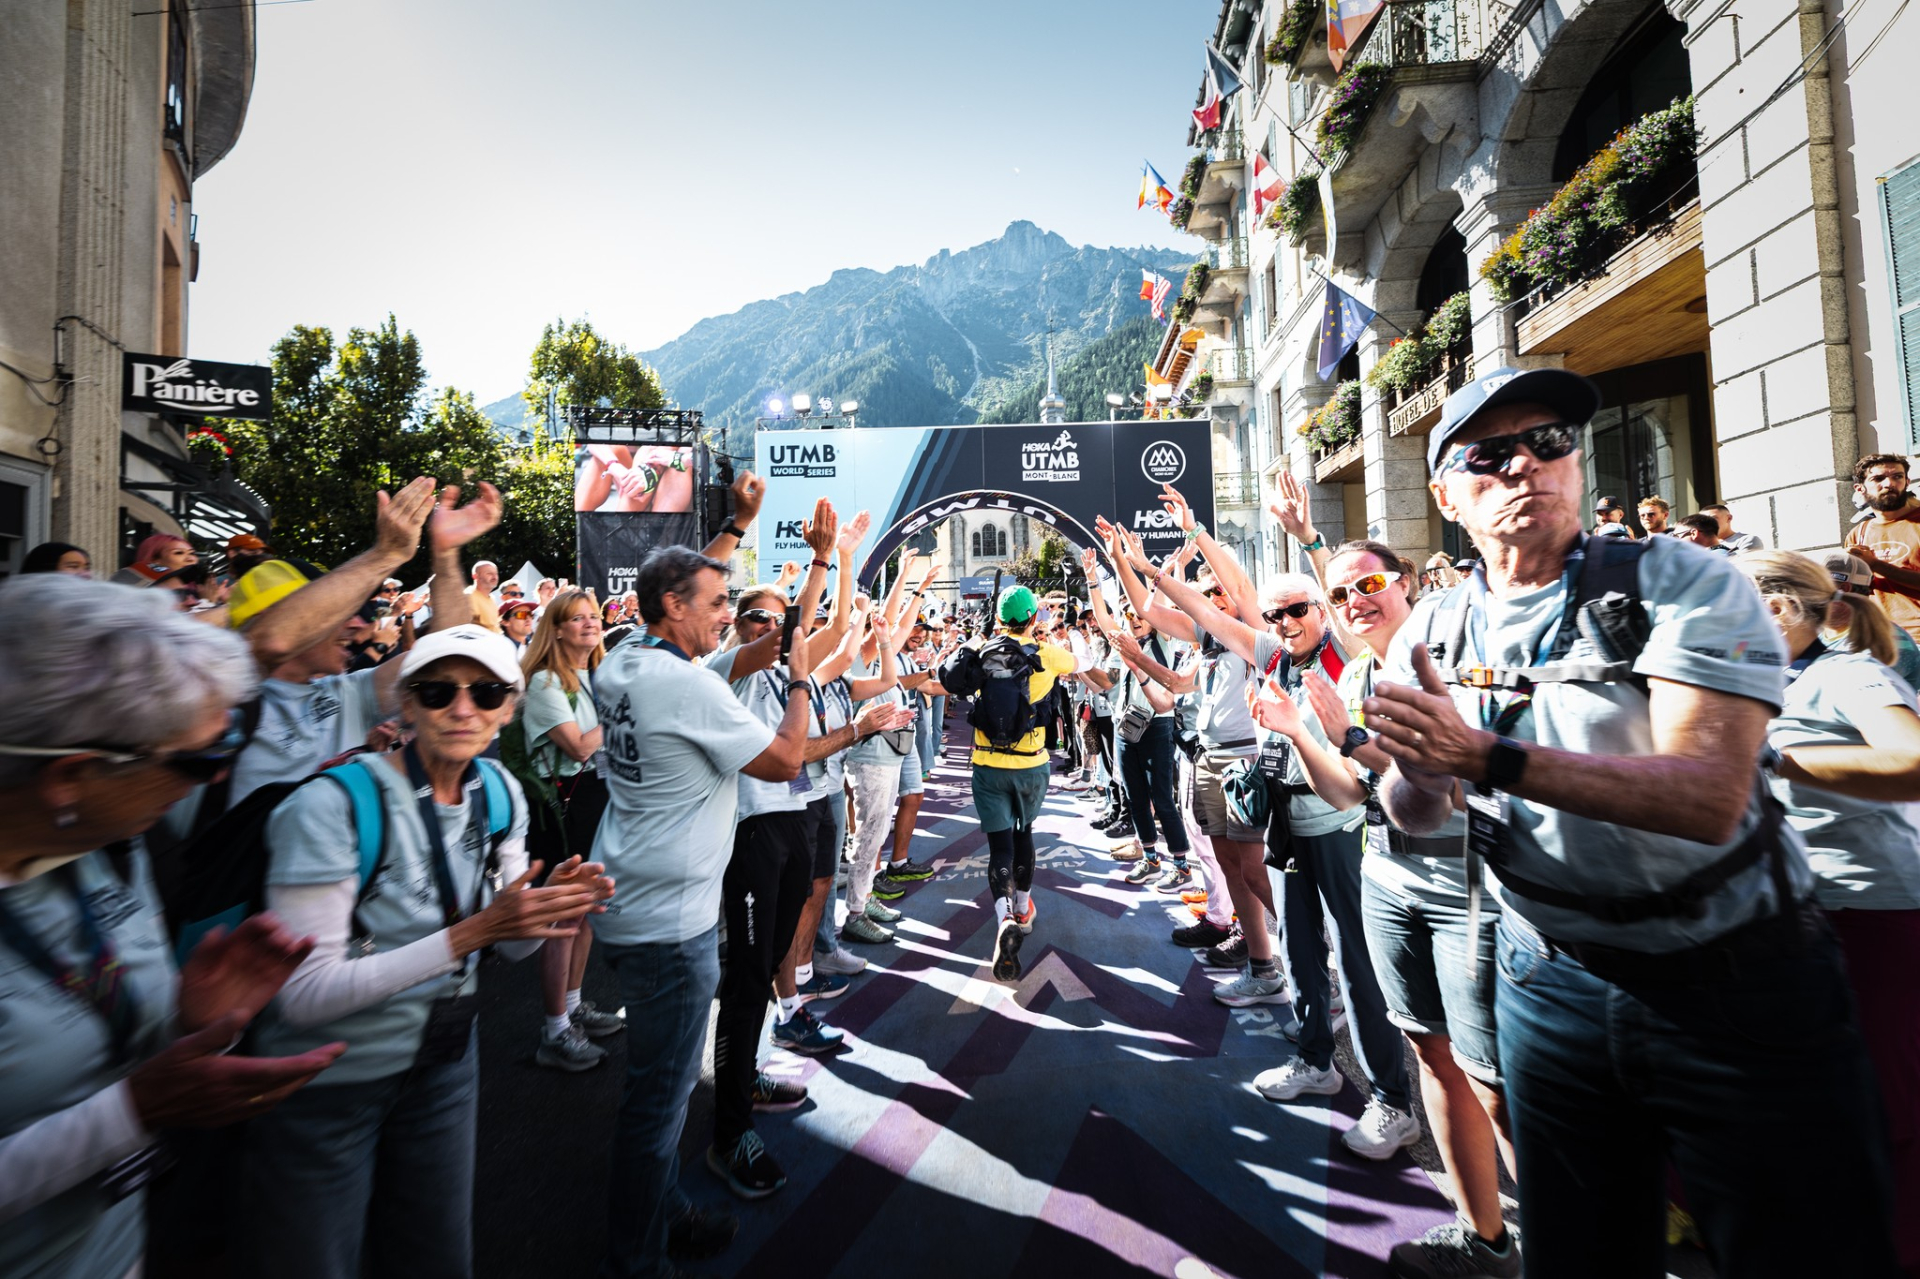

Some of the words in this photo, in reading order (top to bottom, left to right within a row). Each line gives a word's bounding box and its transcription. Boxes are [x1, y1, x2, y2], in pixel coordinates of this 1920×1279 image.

[131, 363, 260, 406] Panière
[1423, 388, 1438, 413] DE
[1022, 442, 1051, 452] HOKA
[770, 444, 836, 464] UTMB
[1021, 451, 1080, 470] UTMB
[772, 467, 804, 475] WORLD
[807, 468, 834, 476] SERIES
[1149, 531, 1180, 540] HUMAN
[775, 542, 788, 550] FLY
[789, 541, 811, 549] HUM
[608, 567, 638, 576] HOKA
[1052, 860, 1087, 868] FLY
